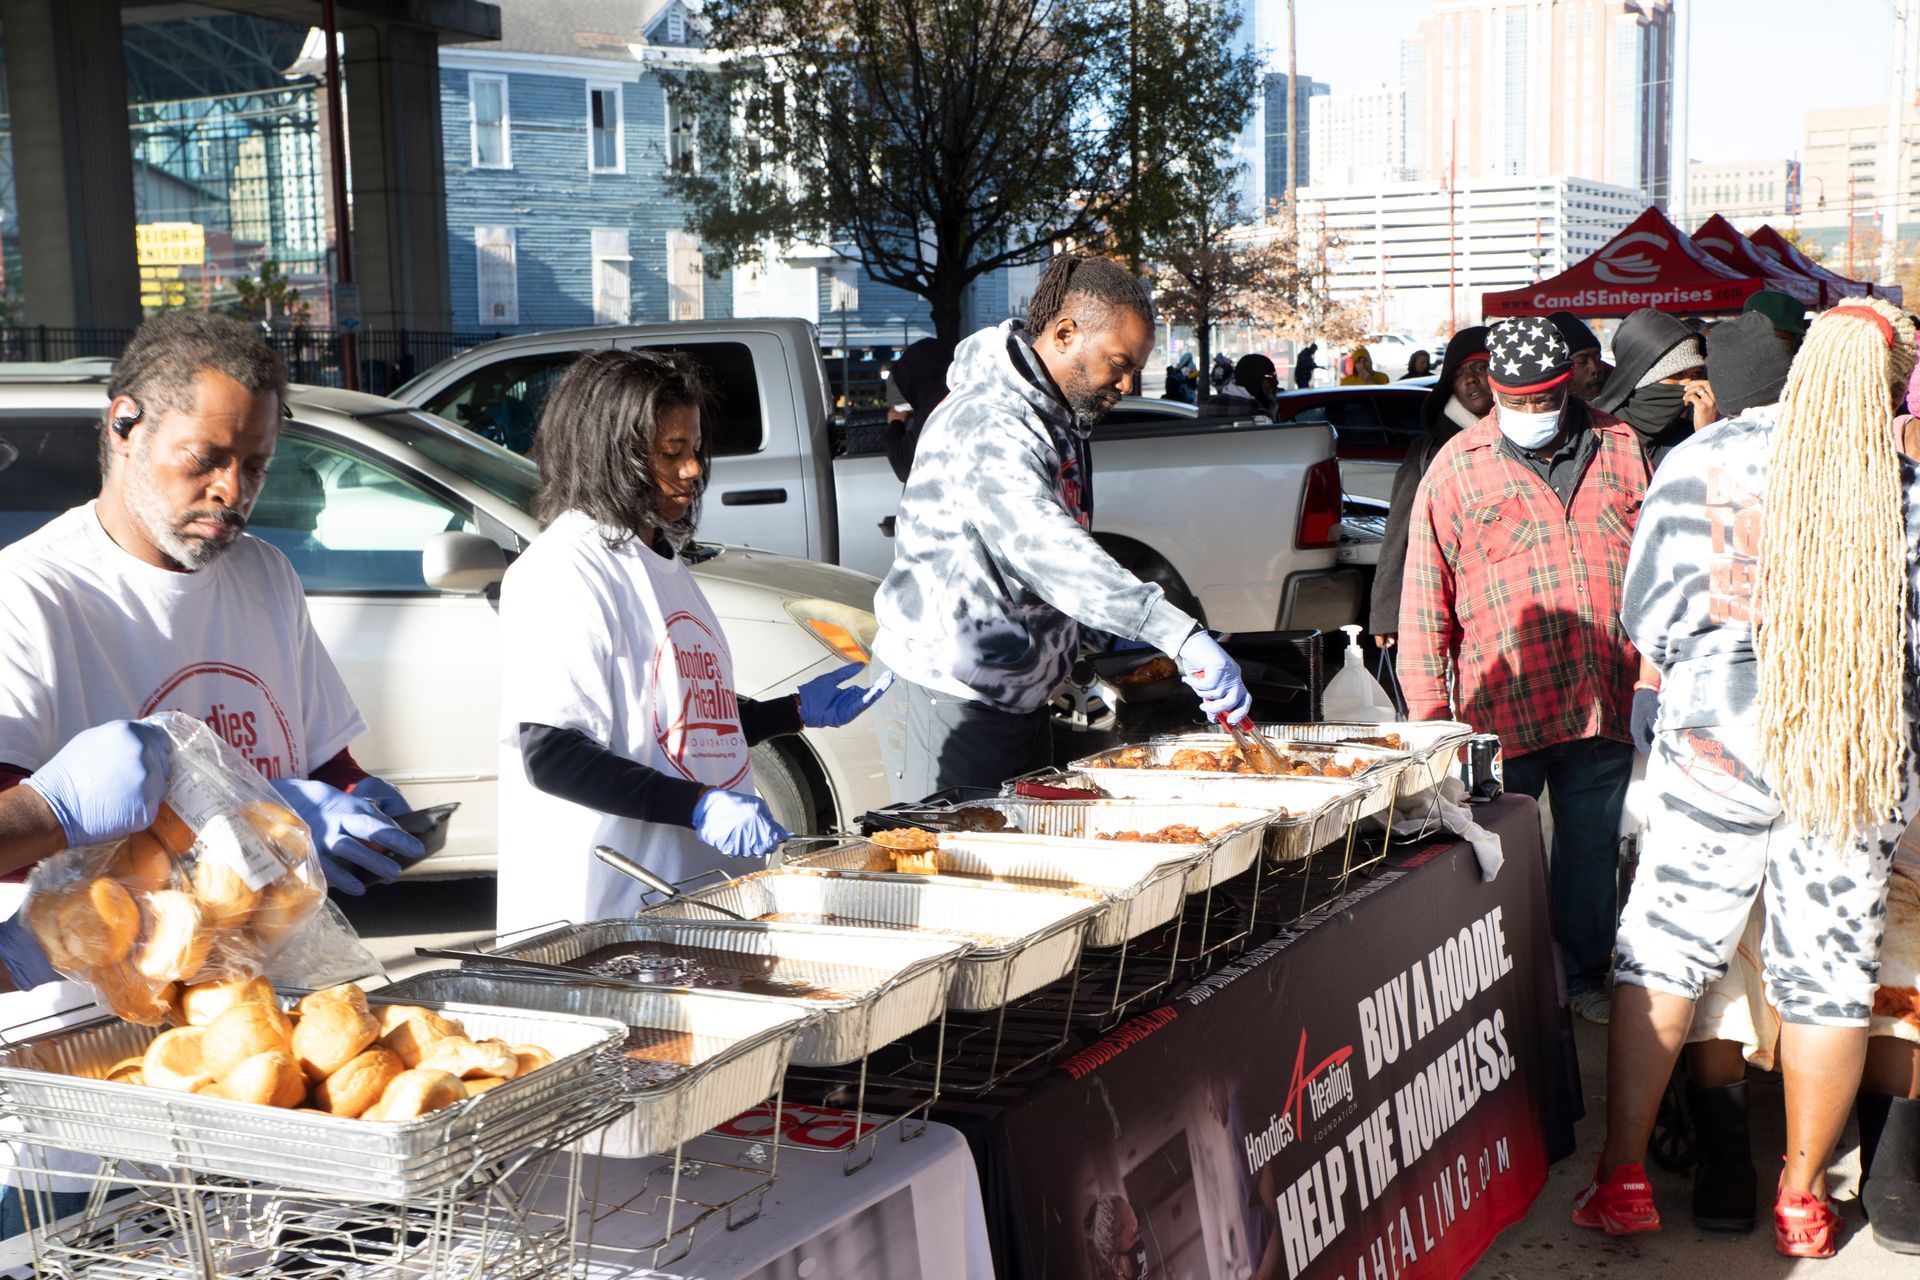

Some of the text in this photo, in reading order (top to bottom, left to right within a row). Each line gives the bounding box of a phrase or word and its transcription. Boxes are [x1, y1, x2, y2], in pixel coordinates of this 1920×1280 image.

[691, 679, 738, 720] Healin
[1358, 971, 1412, 1080] BUY
[1412, 960, 1435, 1040] A
[1428, 905, 1513, 1025] HOODIE.
[1245, 1112, 1294, 1176] Hoodies
[1308, 1061, 1354, 1122] Healing
[1276, 1008, 1516, 1280] HELP THE HOMELESS.
[1314, 1102, 1359, 1144] FOUNDATION
[1623, 1182, 1645, 1191] TREND
